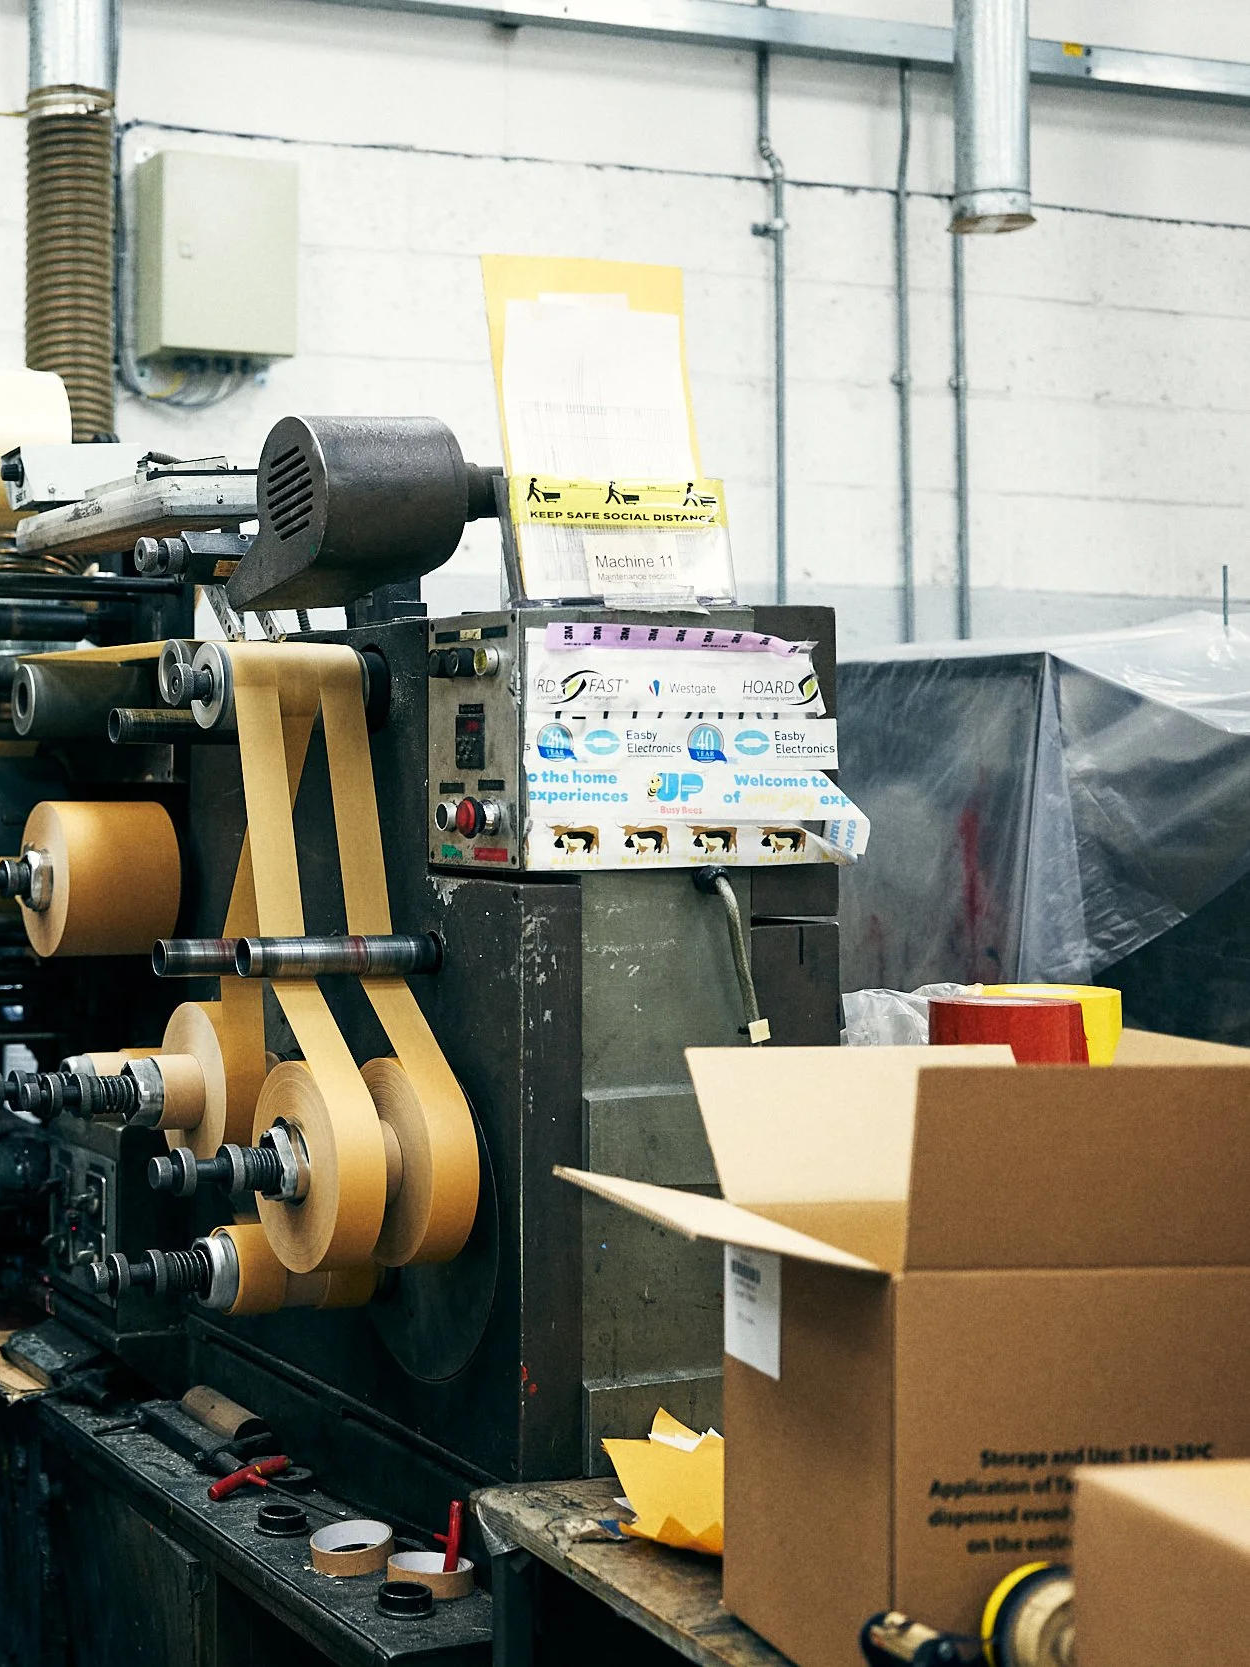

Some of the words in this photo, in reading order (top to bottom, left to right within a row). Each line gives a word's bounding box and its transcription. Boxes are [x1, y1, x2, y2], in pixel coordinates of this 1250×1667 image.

[530, 511, 563, 519] KEEP
[567, 512, 600, 520] SAFE
[603, 513, 650, 521] SOCIAL
[595, 555, 655, 568] Machine
[659, 555, 673, 567] 11
[597, 573, 647, 581] Maintenance
[564, 625, 573, 640] 3M
[593, 626, 602, 640] 3M
[620, 627, 631, 641] 3M
[648, 628, 659, 641] 3M
[675, 629, 687, 642] 3M
[703, 631, 715, 643] 3M
[669, 683, 716, 697] Westgate
[742, 680, 795, 694] HOARD
[626, 729, 658, 743] Easby
[696, 730, 715, 750] 40
[774, 730, 805, 743] Easby
[627, 742, 682, 753] Electronics
[775, 743, 836, 754] Electronics
[527, 773, 538, 783] o
[541, 770, 569, 784] the
[573, 770, 618, 785] home
[734, 773, 808, 788] Welcome
[811, 775, 829, 788] to
[528, 788, 629, 804] experiences
[723, 791, 742, 804] of
[660, 806, 681, 815] Busy
[682, 806, 703, 815] Bees
[981, 1450, 1048, 1469] Storage
[1051, 1447, 1084, 1465] and
[1152, 1446, 1171, 1462] to
[929, 1478, 1031, 1500] Application
[1034, 1475, 1052, 1494] of
[1055, 1475, 1075, 1494] Ta
[928, 1505, 1019, 1529] dispensed
[1021, 1504, 1071, 1522] evenl
[966, 1539, 991, 1554] on
[993, 1536, 1023, 1552] the
